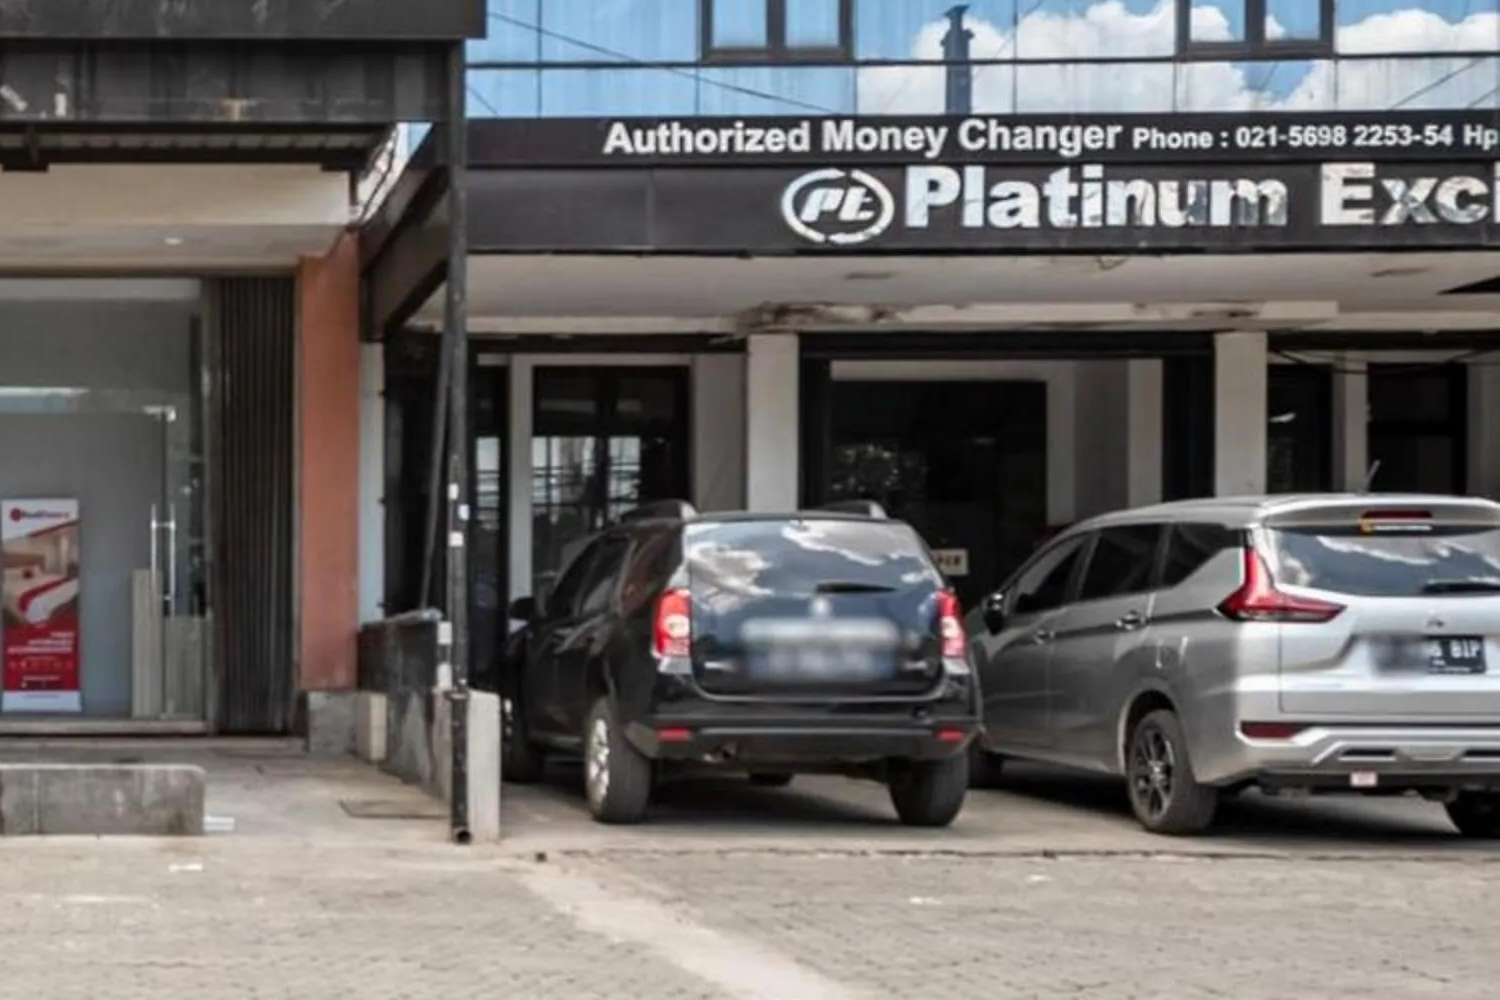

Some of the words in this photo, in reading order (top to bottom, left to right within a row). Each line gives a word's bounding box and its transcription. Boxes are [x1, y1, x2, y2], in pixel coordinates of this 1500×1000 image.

[602, 120, 810, 154] Authorized
[822, 119, 948, 158] Money
[958, 118, 1123, 156] Changer
[1132, 126, 1214, 149] Phone
[1235, 125, 1347, 148] 021-5698
[1353, 124, 1454, 147] 2253-54
[1462, 124, 1499, 151] Hp
[904, 164, 1288, 229] Platinum
[1320, 161, 1500, 226] Exc
